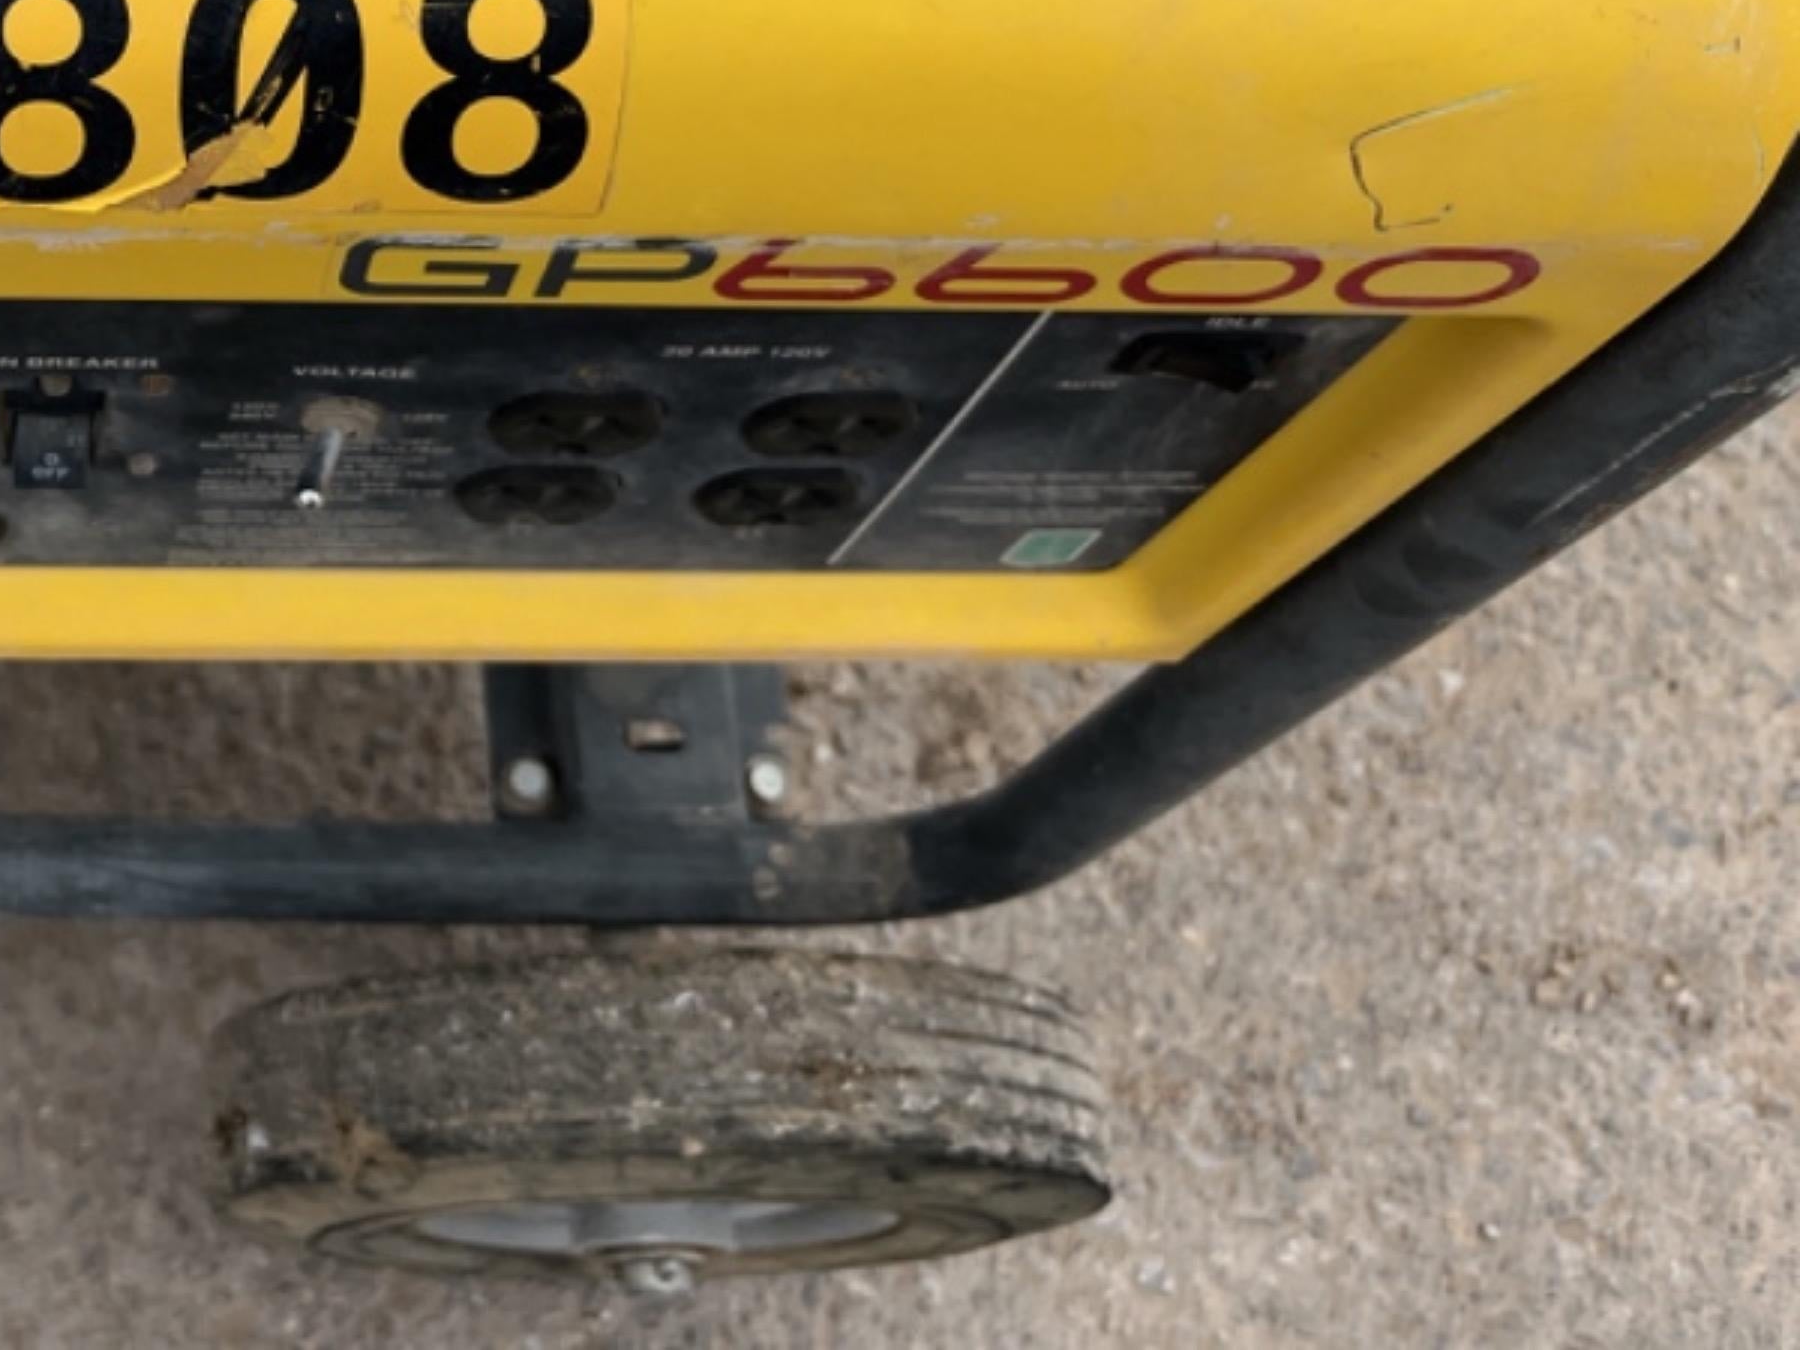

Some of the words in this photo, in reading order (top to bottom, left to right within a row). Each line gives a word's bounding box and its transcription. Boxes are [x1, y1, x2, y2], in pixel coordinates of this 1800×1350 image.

[338, 236, 1542, 310] GP6600
[26, 356, 159, 370] BREAKER
[293, 365, 416, 380] VOLTAGE
